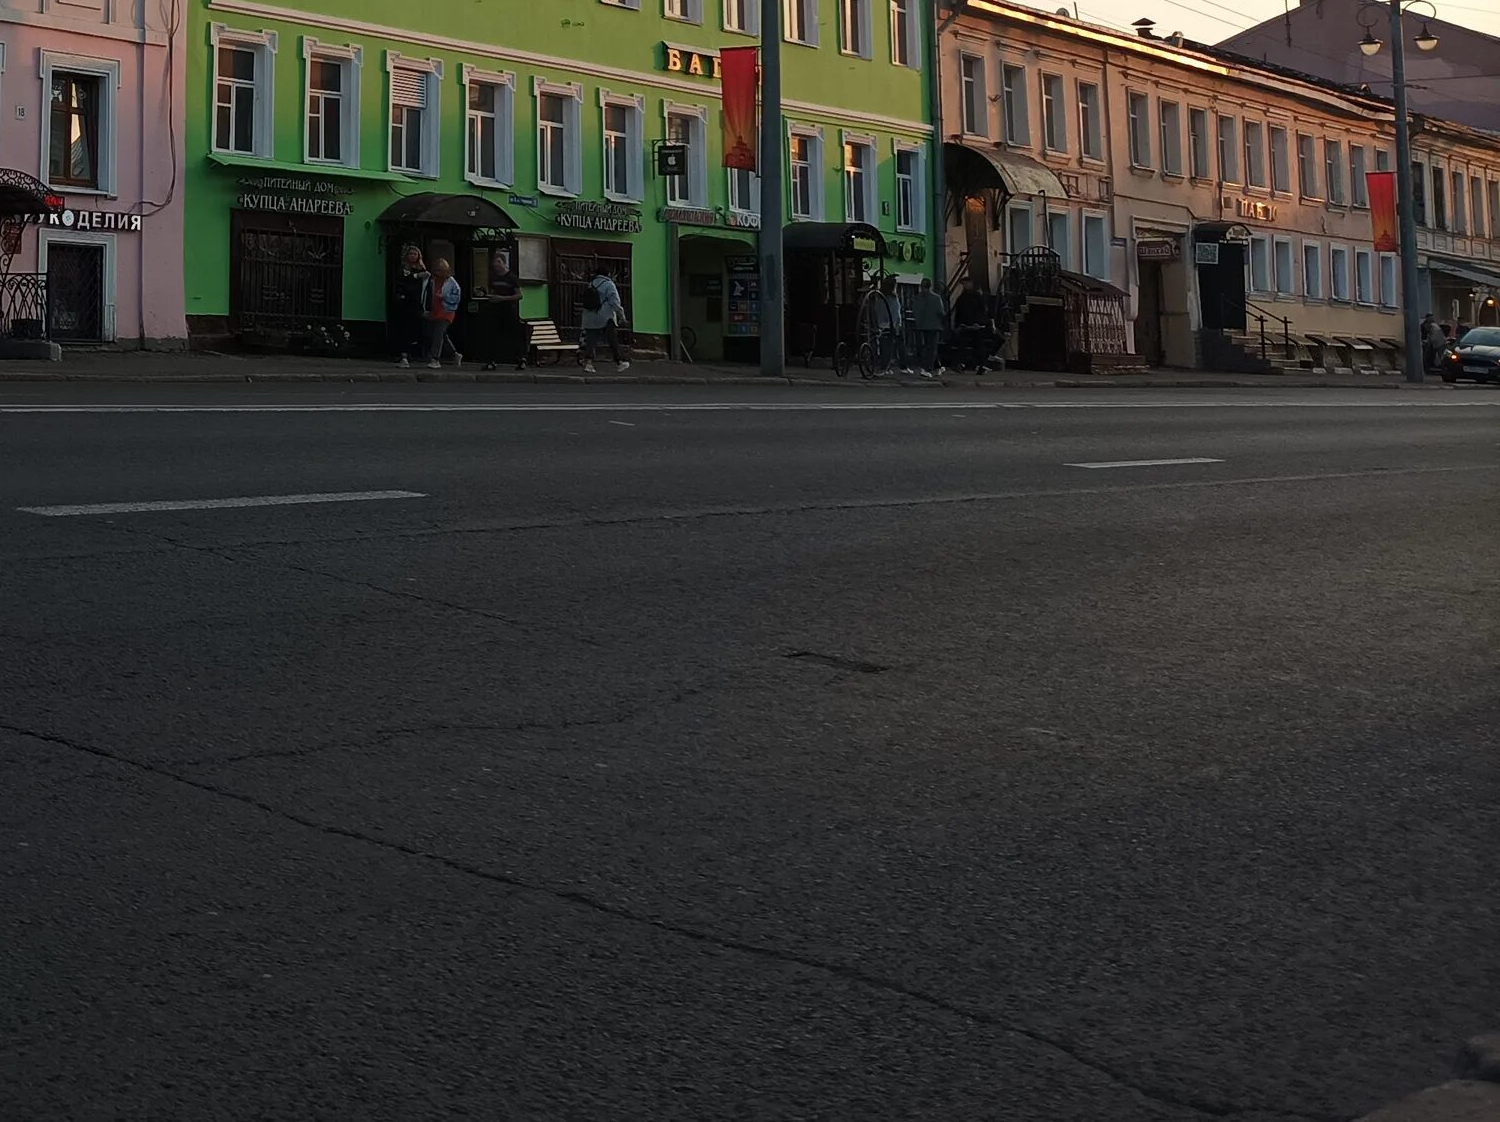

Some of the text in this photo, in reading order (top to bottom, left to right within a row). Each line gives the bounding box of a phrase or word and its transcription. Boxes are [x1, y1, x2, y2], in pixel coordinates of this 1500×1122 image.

[314, 181, 334, 194] ДОМ
[243, 193, 352, 215] КУПЦА АНДРЕЕВА
[560, 213, 640, 233] КУПЦА АНДРЕЕВА
